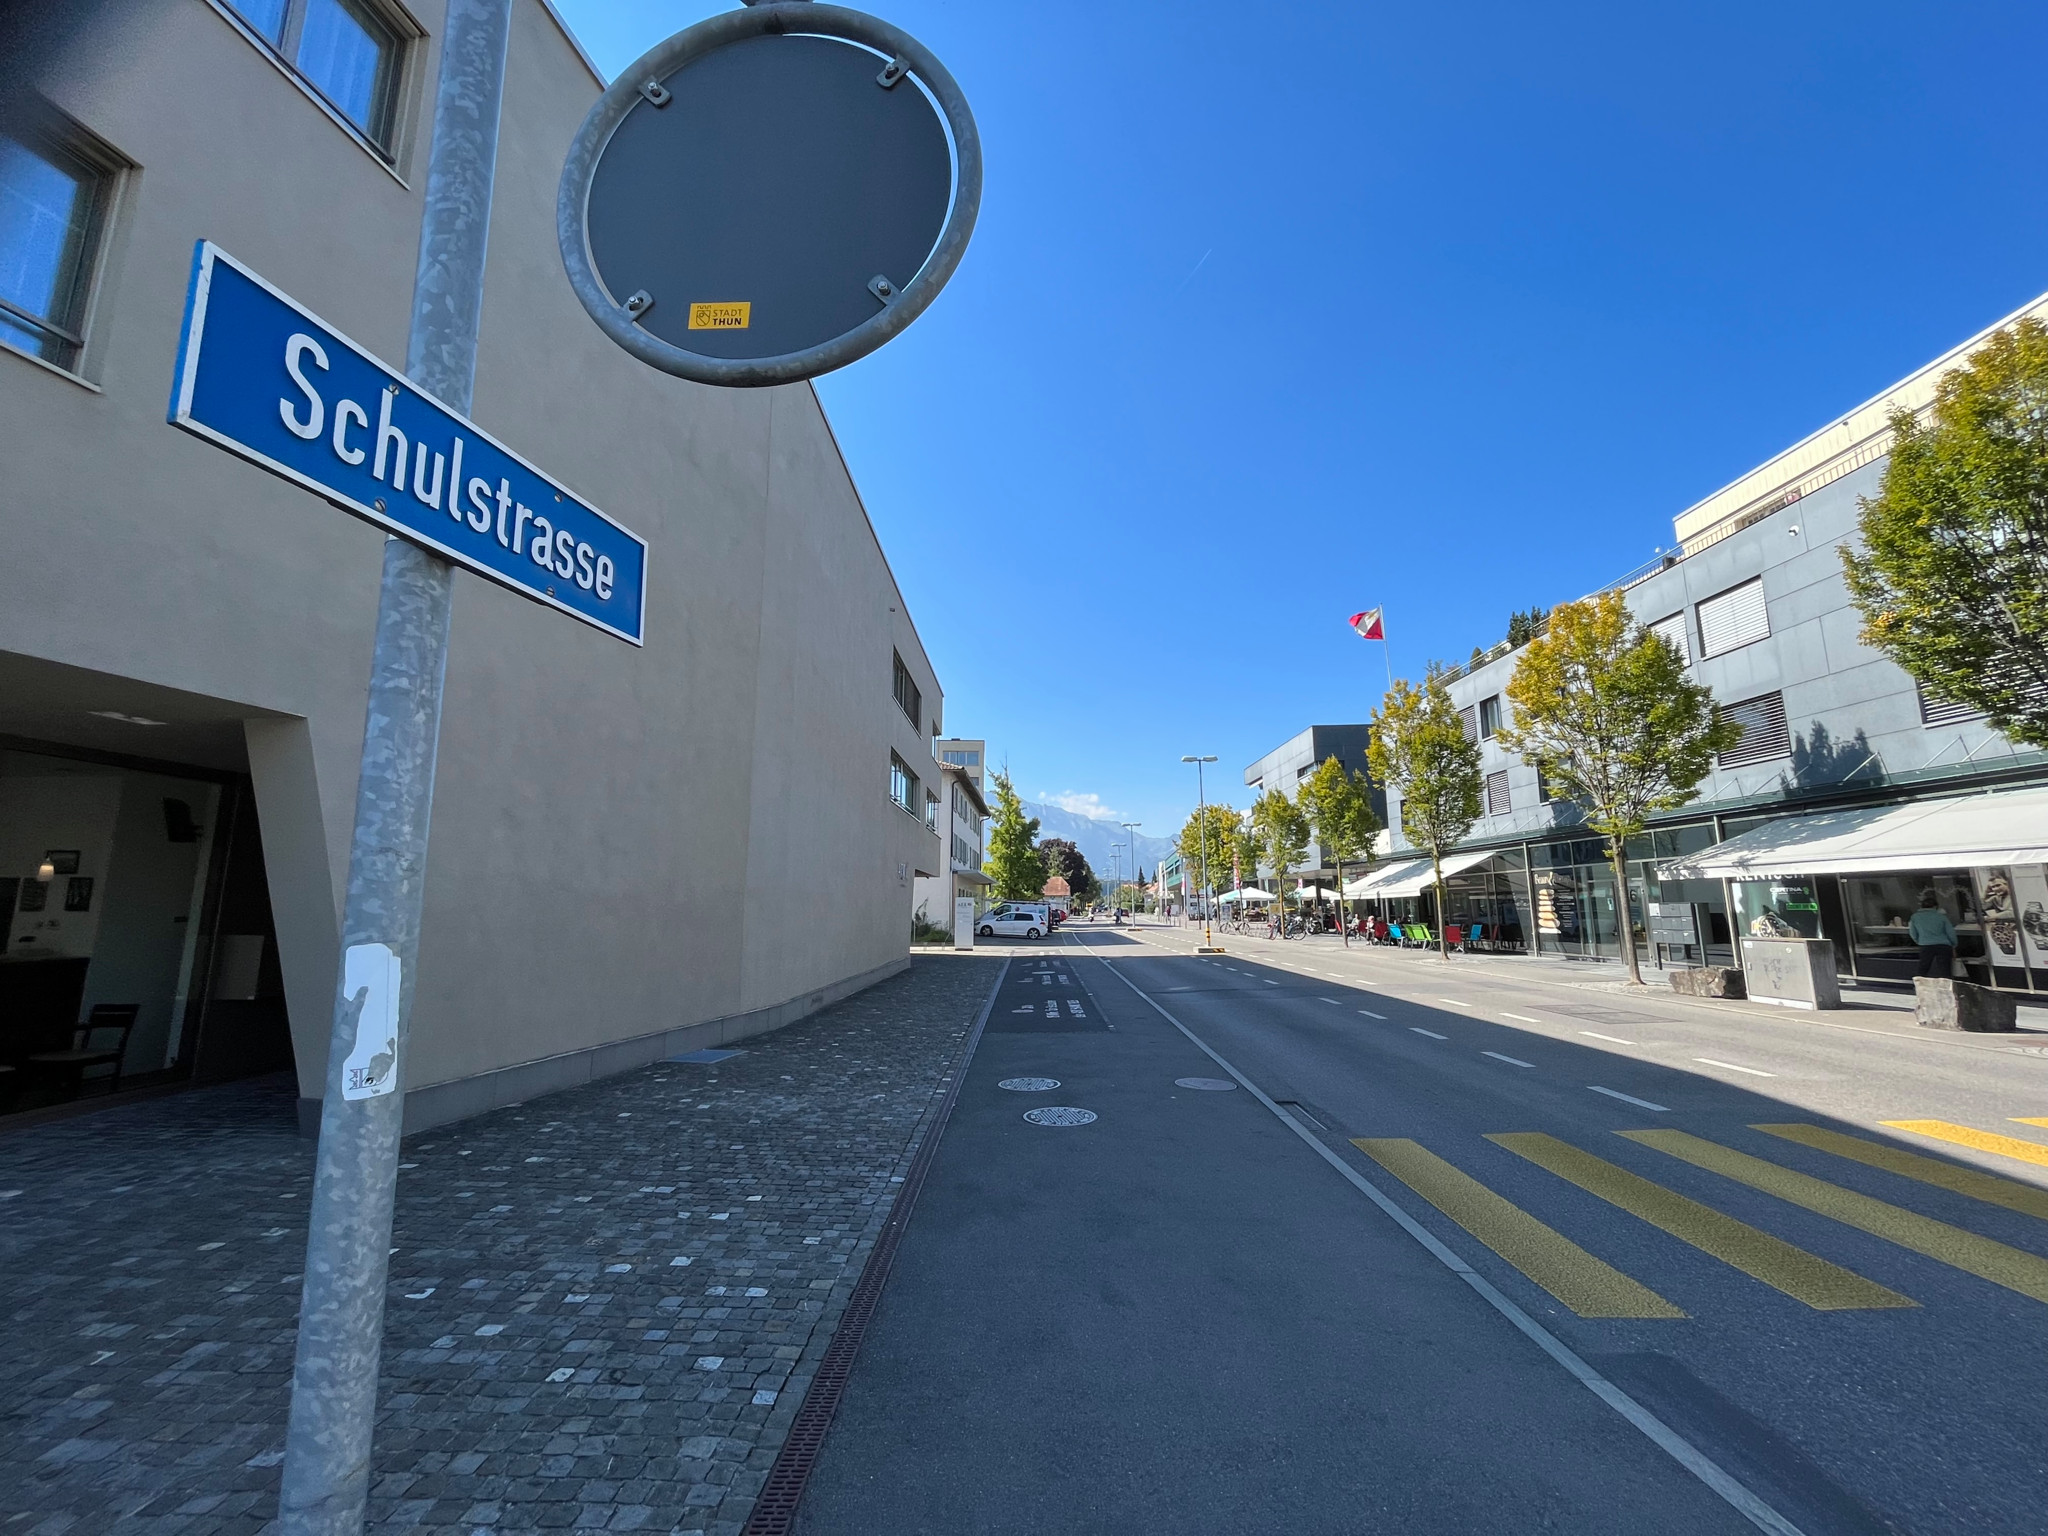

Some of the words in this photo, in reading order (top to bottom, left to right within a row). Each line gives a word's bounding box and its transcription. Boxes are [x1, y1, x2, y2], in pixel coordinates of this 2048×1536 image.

[713, 309, 743, 317] STADT
[713, 318, 742, 326] THUN
[279, 333, 615, 602] Schulstrasse
[1630, 889, 1637, 902] 6
